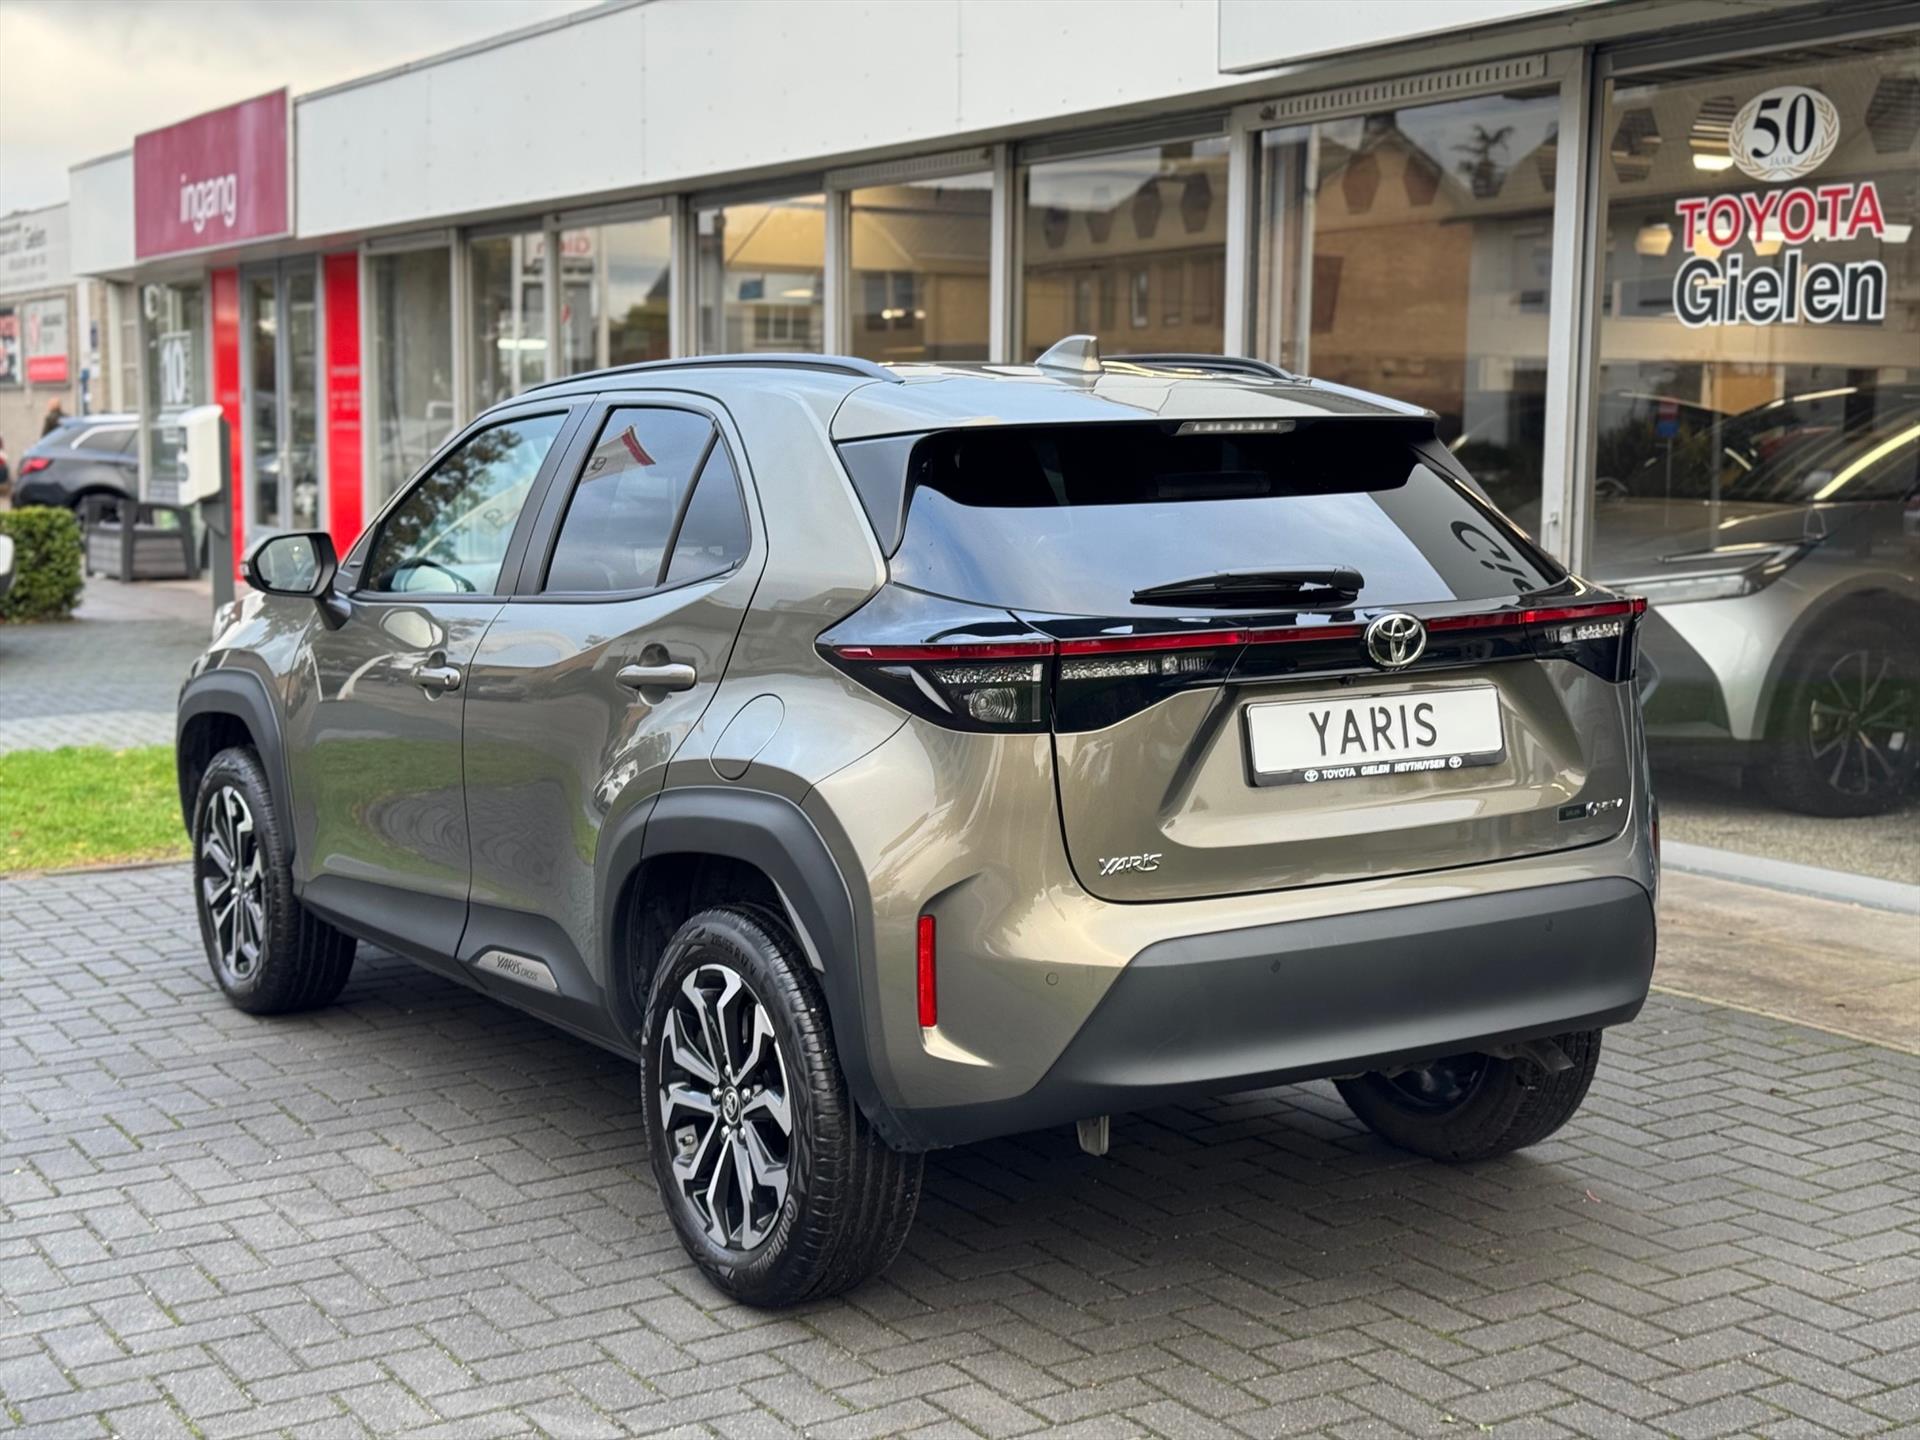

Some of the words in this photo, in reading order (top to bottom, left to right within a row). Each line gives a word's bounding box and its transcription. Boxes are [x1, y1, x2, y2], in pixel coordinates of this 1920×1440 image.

[1752, 92, 1816, 159] 50
[1769, 155, 1793, 168] JAAR
[180, 173, 237, 234] ingang
[1676, 183, 1885, 252] TOYOTA
[1674, 250, 1888, 328] Gielen
[1308, 702, 1438, 757] YARIS
[1321, 768, 1356, 780] TOYOTA
[1360, 763, 1390, 776] GIELEN
[1394, 758, 1446, 774] HEYTHUYSEN
[1099, 853, 1162, 876] YARIS
[496, 954, 522, 976] YARIS
